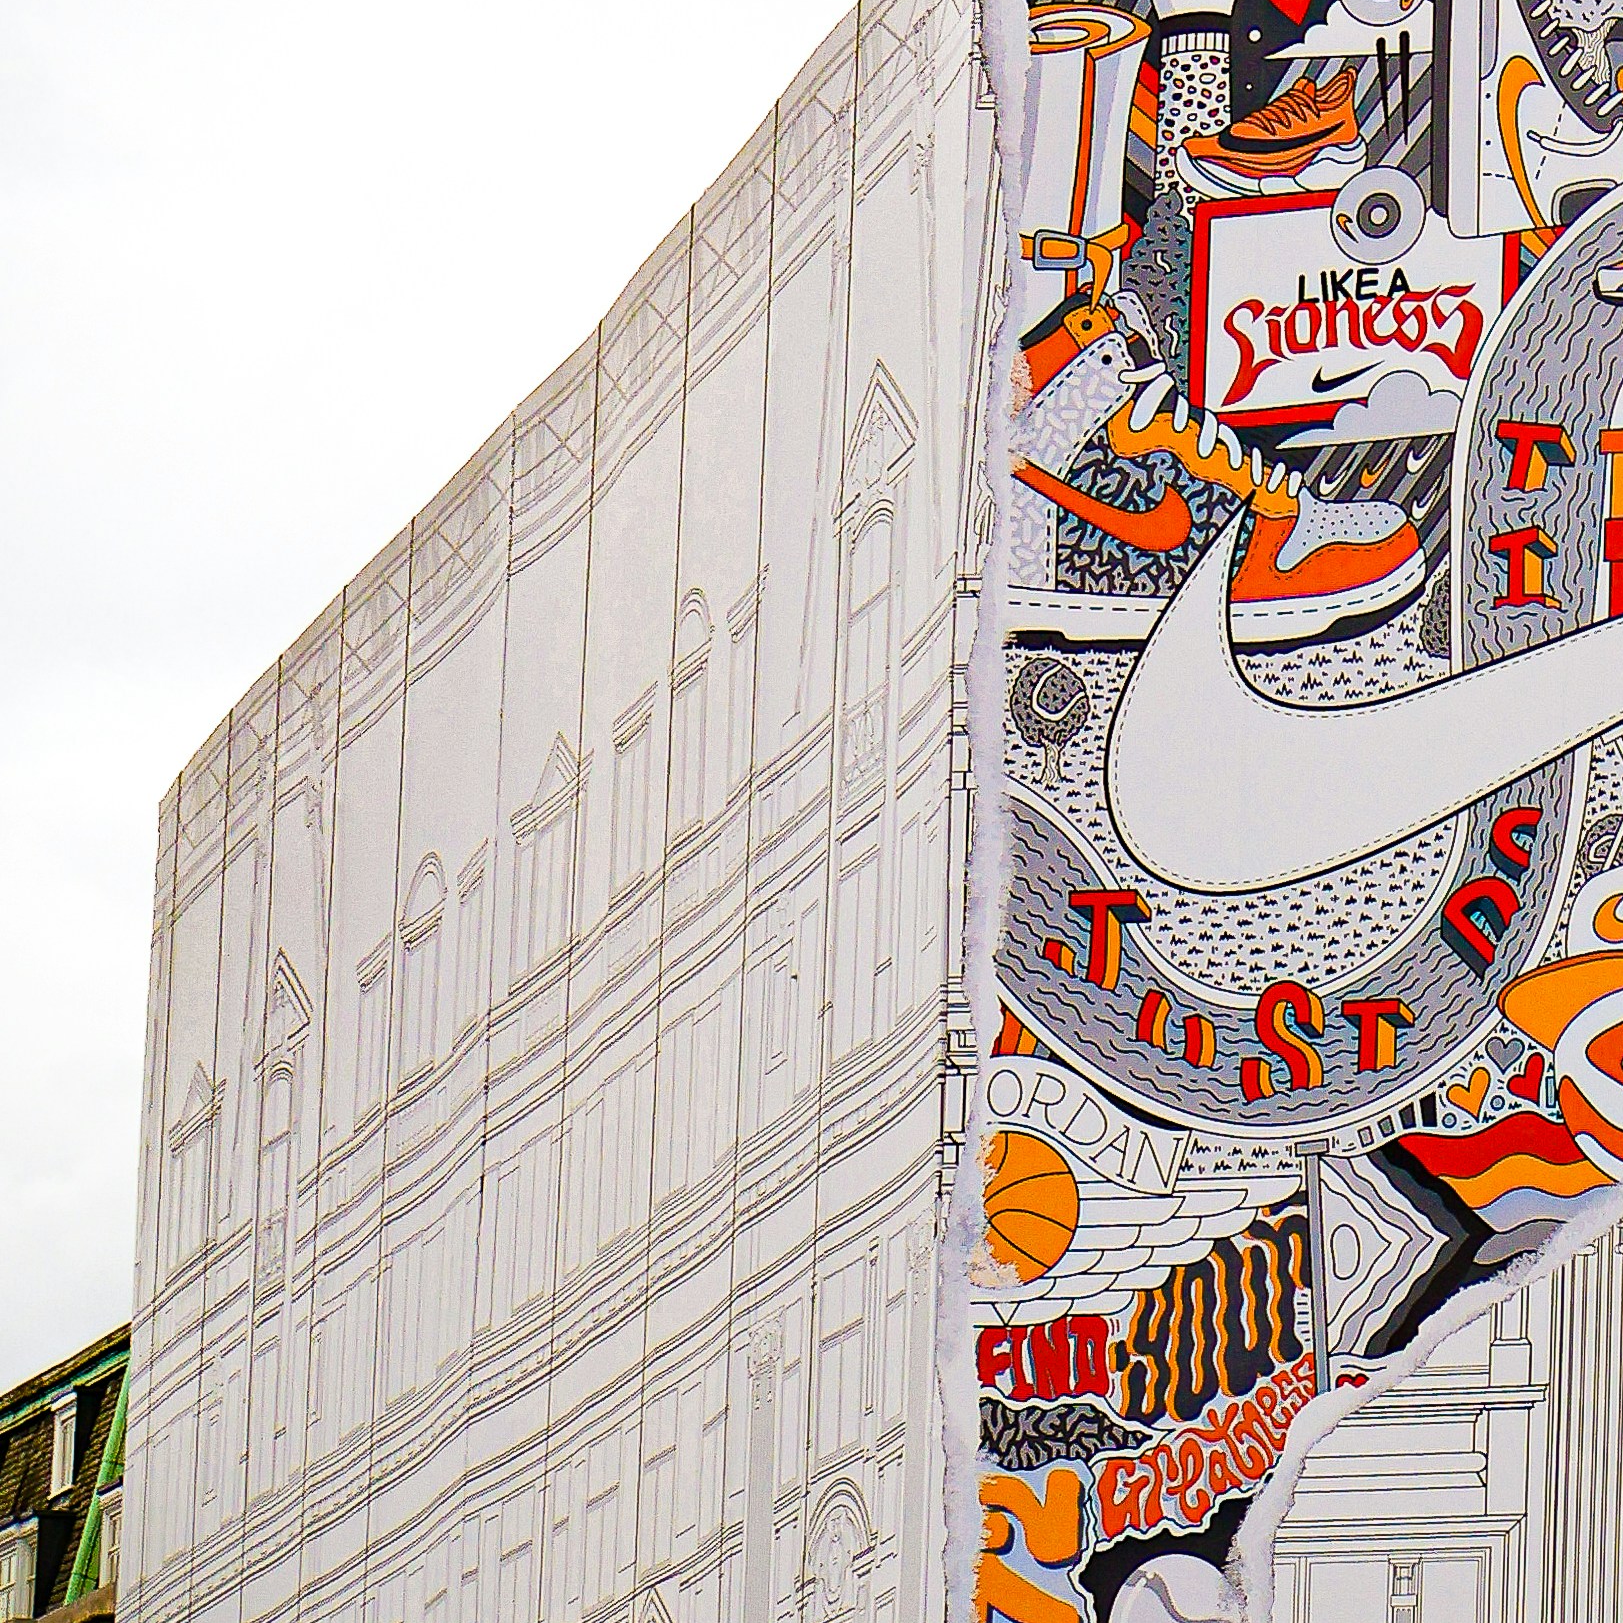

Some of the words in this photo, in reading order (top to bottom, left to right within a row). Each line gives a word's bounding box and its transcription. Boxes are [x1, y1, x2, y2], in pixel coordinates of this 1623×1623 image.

[1298, 267, 1379, 303] LIKE
[1388, 267, 1411, 297] A
[1222, 283, 1484, 407] Lioness
[977, 1316, 1109, 1401] FIND
